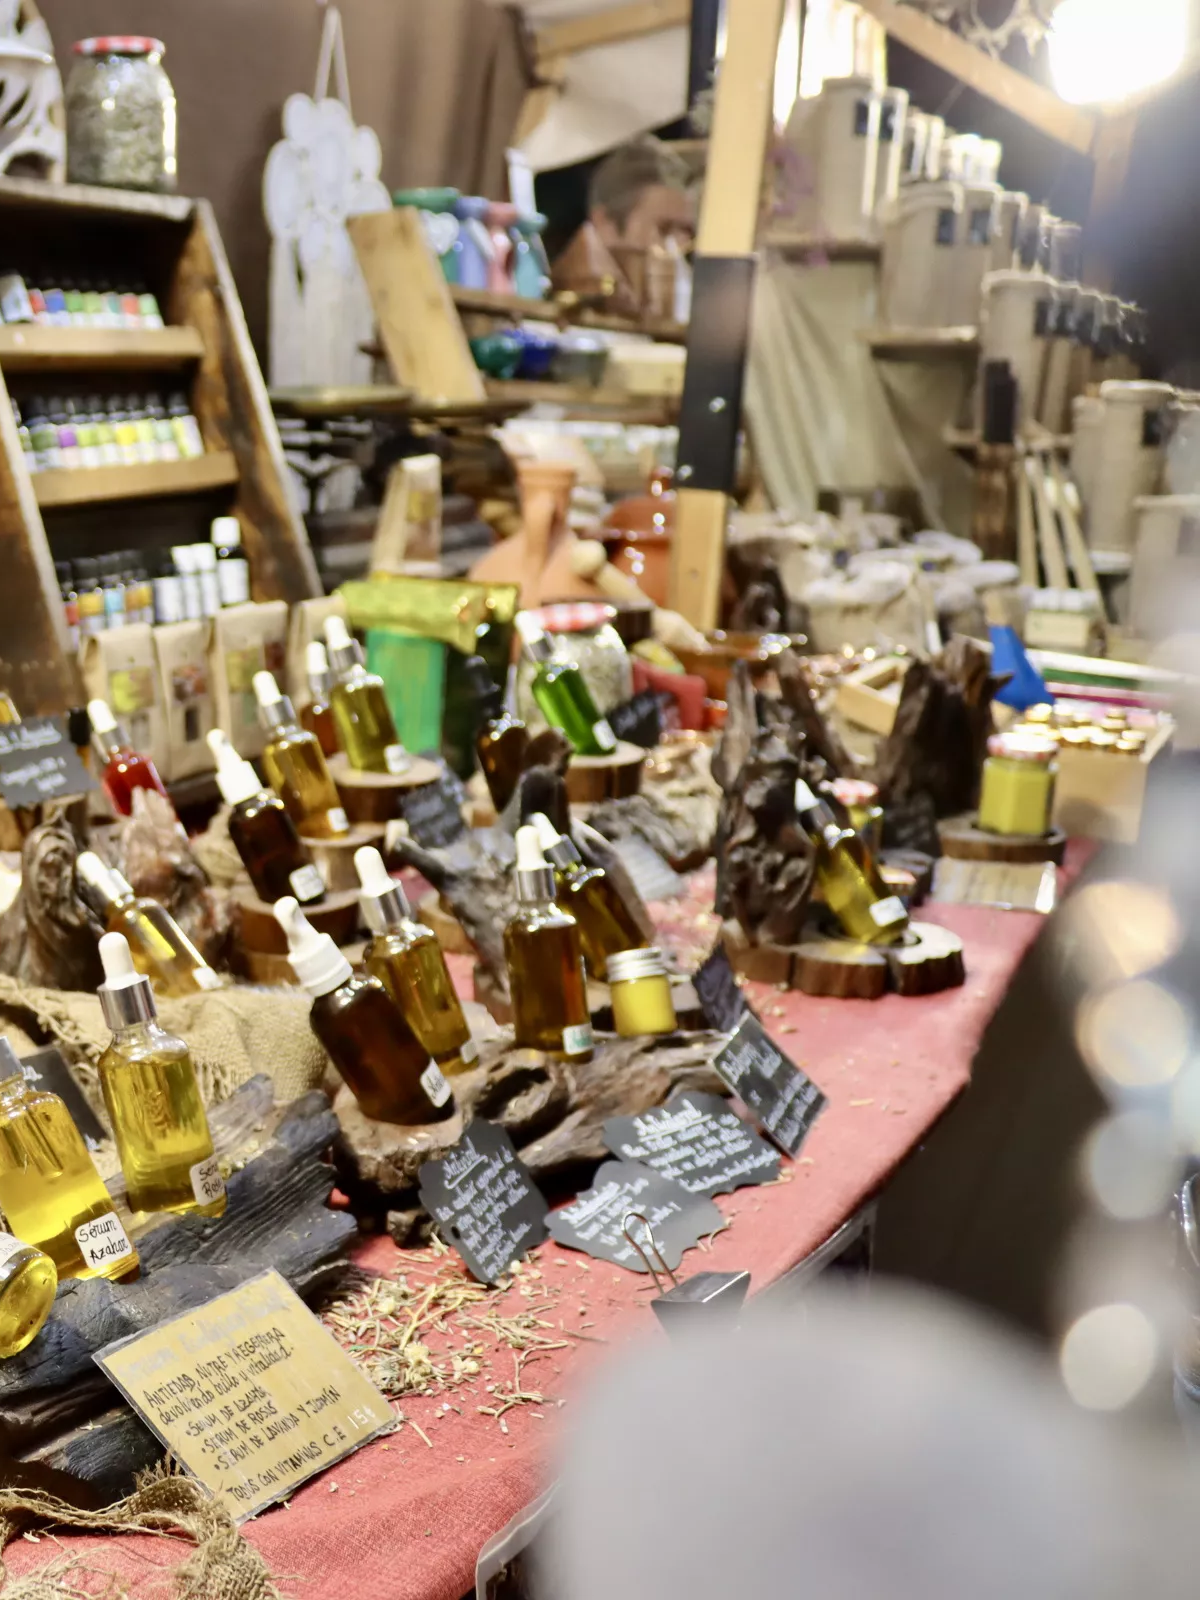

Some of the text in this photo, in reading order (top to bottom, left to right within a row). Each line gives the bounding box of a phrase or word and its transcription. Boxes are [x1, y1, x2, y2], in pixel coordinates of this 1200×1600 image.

[78, 1218, 117, 1243] Sérum
[89, 1237, 129, 1265] Azahar
[220, 1405, 235, 1421] DE
[235, 1418, 251, 1432] DE
[249, 1435, 265, 1449] DE
[297, 1404, 311, 1418] Y
[257, 1471, 280, 1488] CON
